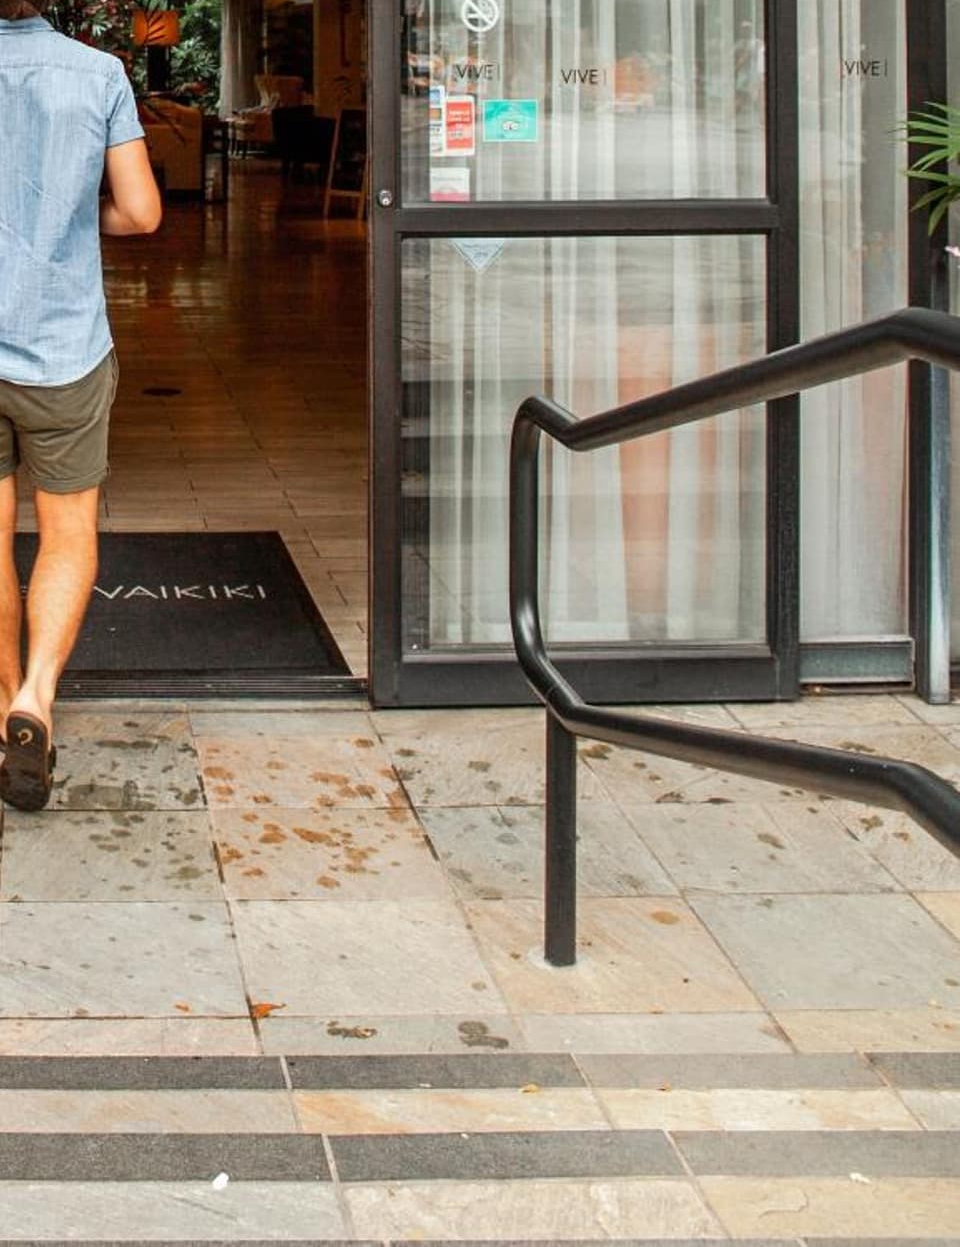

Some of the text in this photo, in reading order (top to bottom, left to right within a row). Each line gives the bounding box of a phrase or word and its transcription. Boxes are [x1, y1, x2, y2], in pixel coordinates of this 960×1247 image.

[455, 63, 494, 81] VIVE
[560, 68, 599, 85] VIVE
[844, 60, 881, 77] VIVE
